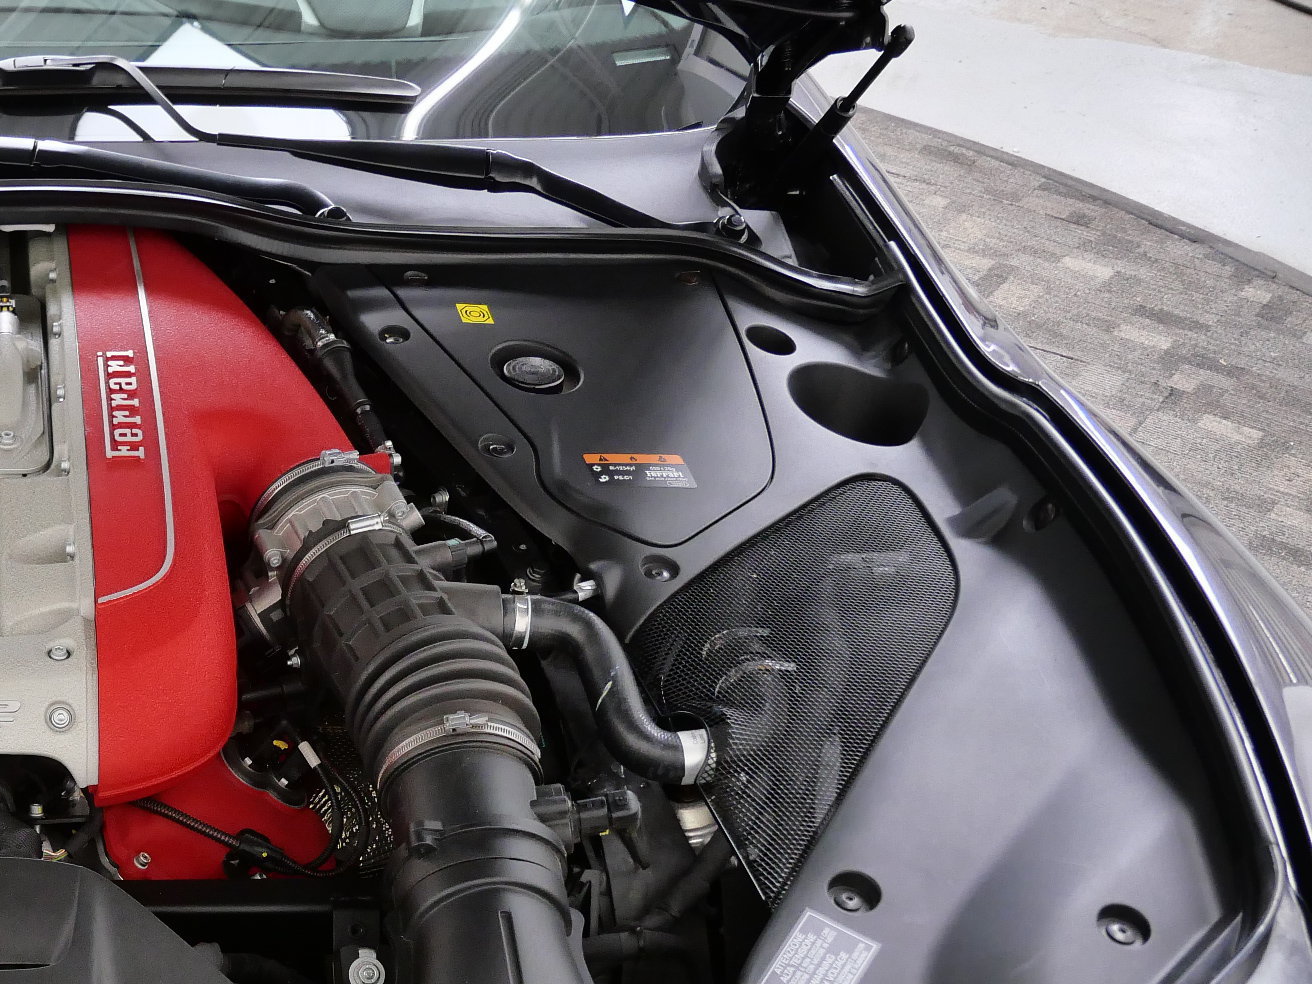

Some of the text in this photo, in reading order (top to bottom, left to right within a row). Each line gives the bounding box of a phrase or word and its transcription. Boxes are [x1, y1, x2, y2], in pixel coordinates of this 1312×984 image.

[96, 349, 146, 460] Ferrari
[645, 470, 685, 478] Ferrari
[774, 931, 806, 975] ATTENZIONE
[779, 932, 817, 984] ALTA TENSIONE
[825, 951, 850, 981] VOLTAGE
